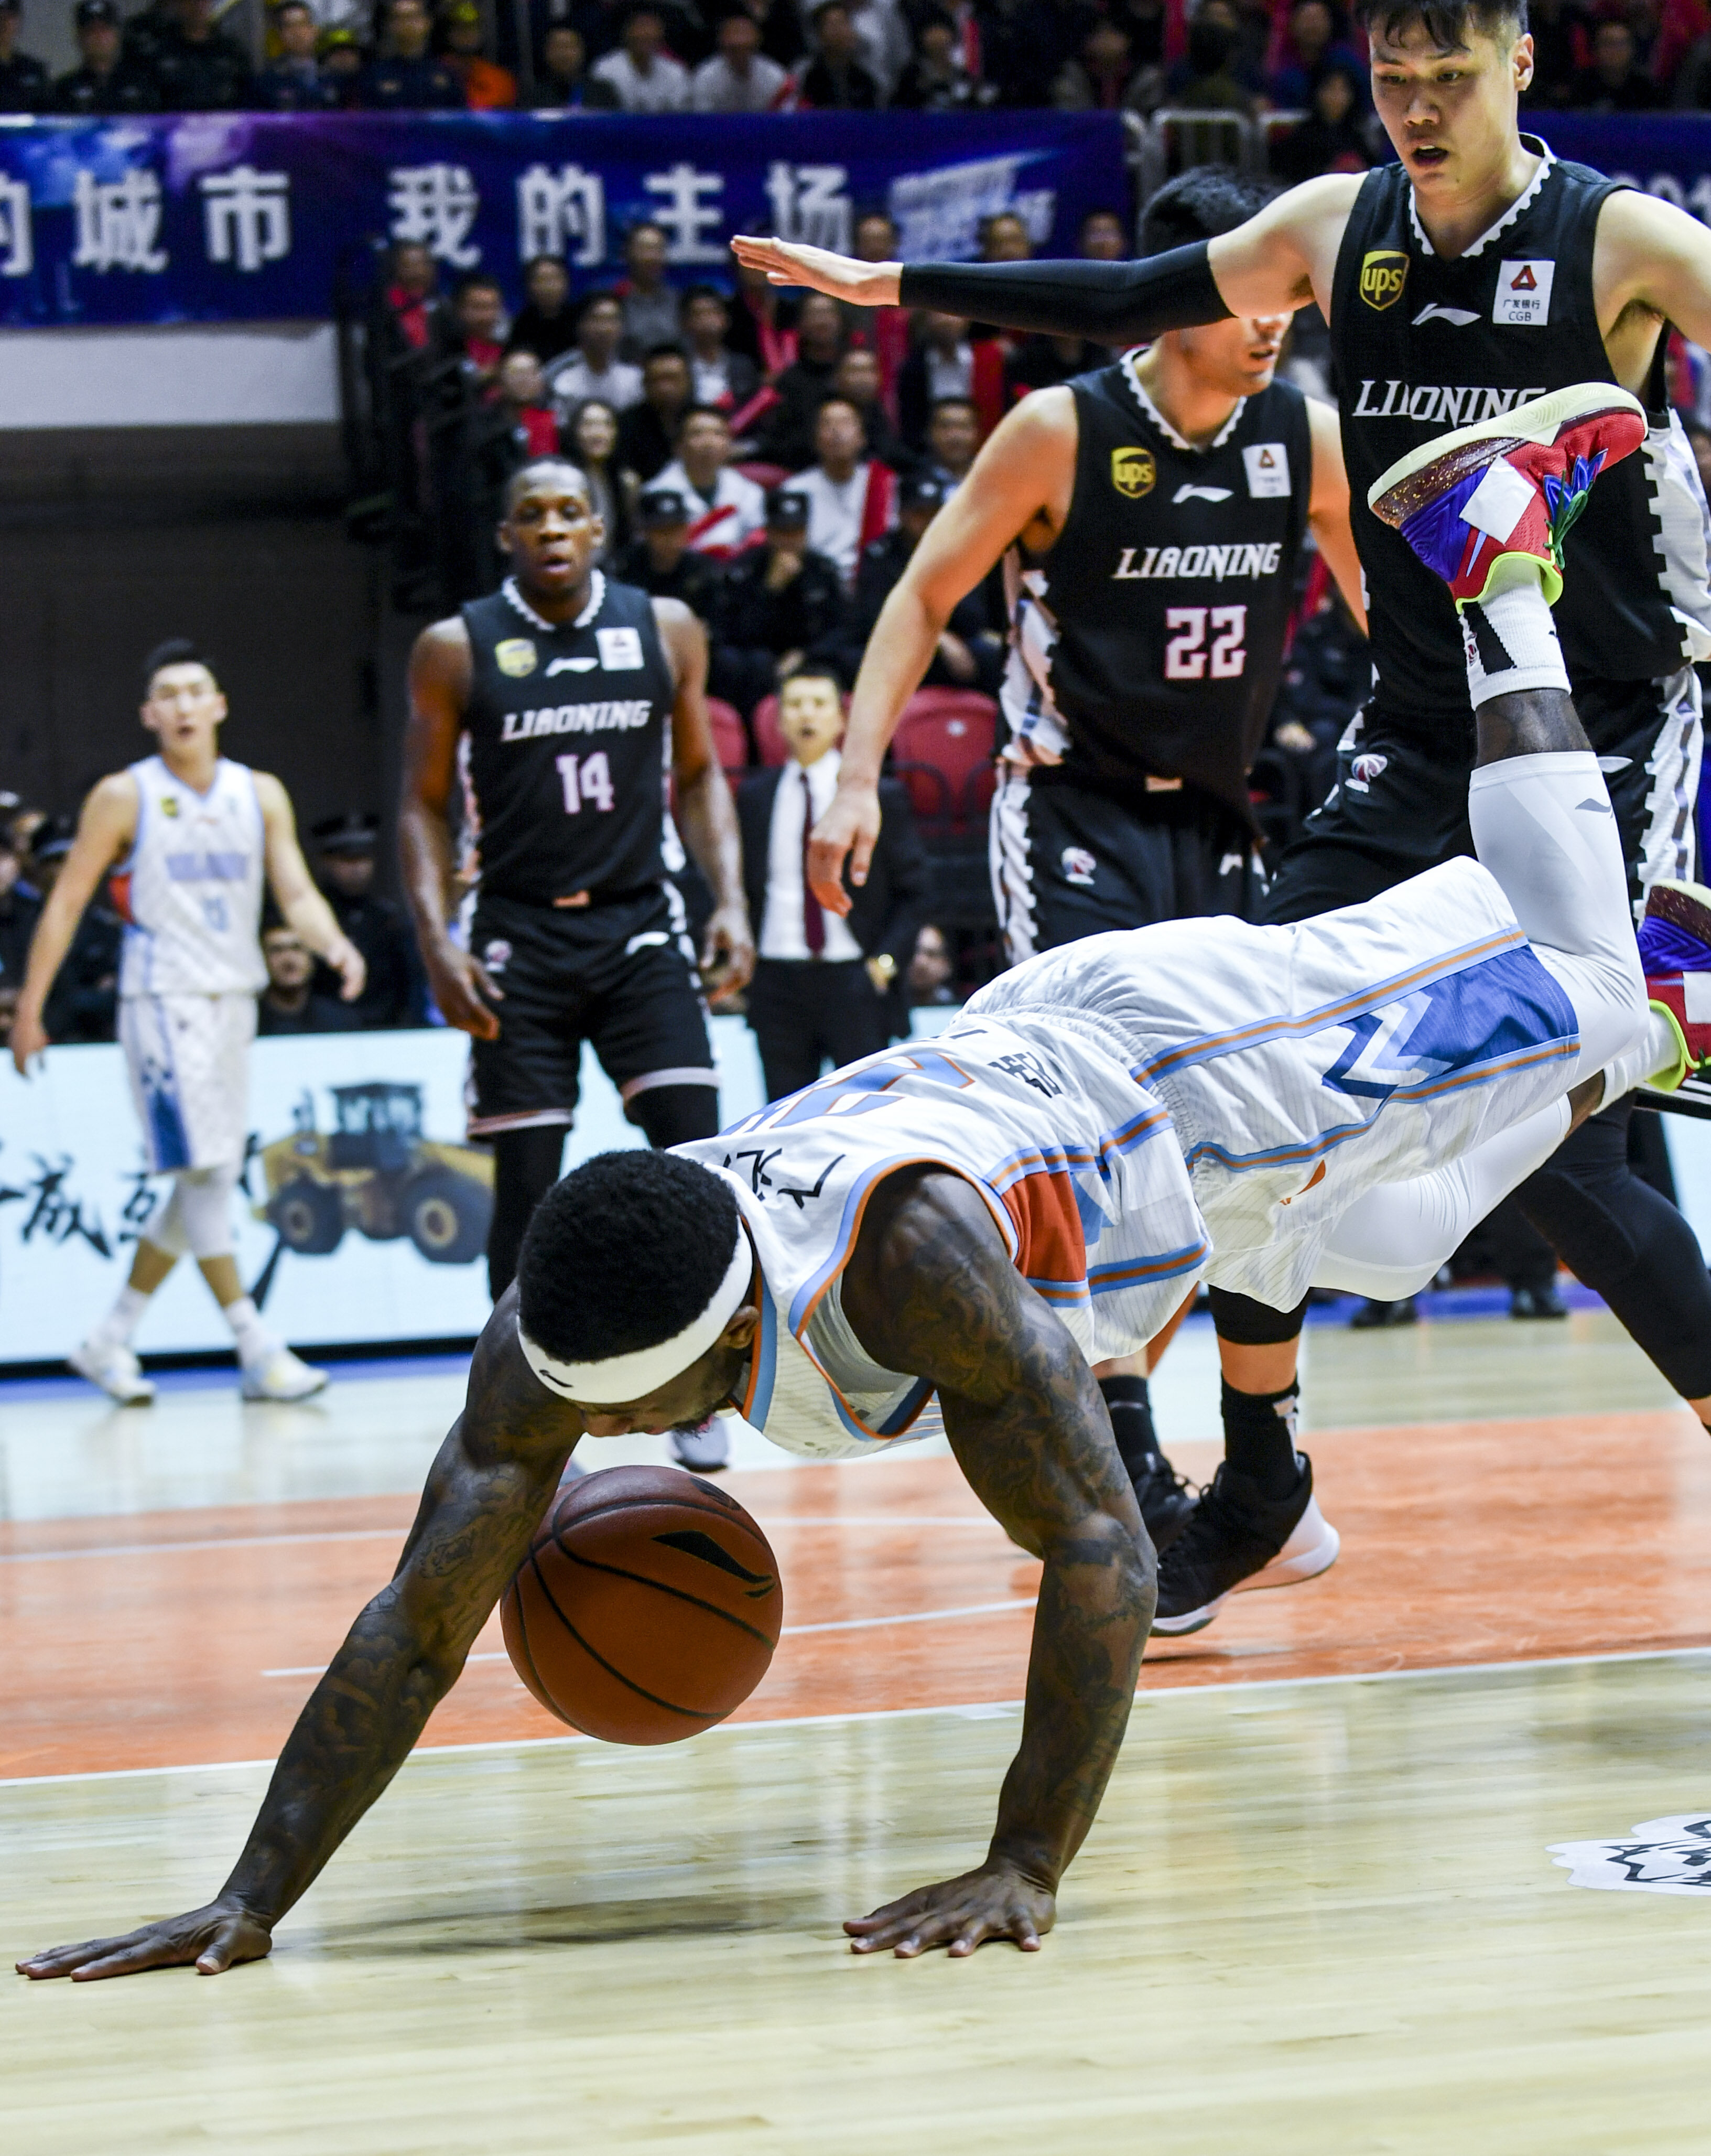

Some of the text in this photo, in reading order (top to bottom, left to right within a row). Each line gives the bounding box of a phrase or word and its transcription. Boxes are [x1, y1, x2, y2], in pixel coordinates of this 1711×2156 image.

[1363, 268, 1403, 301] ups
[1508, 311, 1532, 321] CGB
[1111, 542, 1283, 583] LIAONING
[1165, 605, 1248, 680] 22
[501, 699, 653, 742] LIAONING
[556, 751, 615, 815] 14
